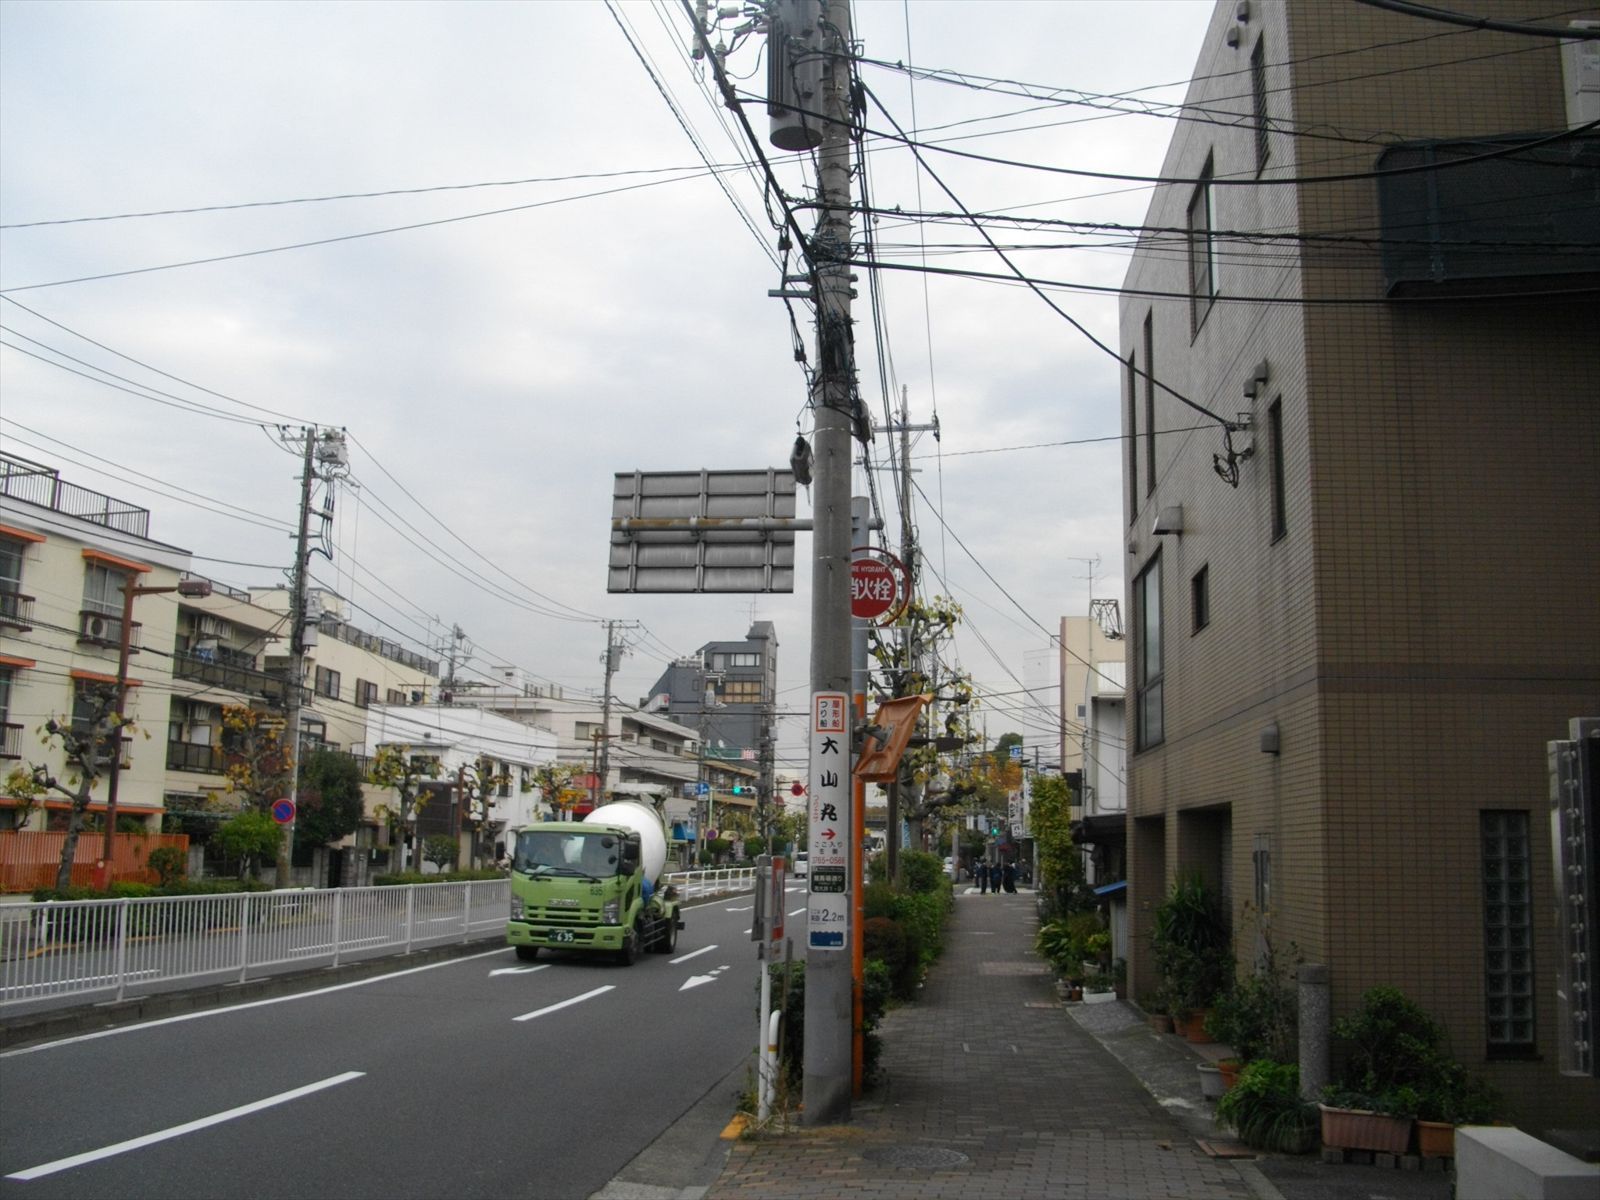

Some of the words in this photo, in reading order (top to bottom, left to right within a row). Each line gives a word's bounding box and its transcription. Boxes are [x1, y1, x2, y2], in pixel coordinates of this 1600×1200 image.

[820, 700, 828, 728] つり船
[822, 908, 845, 922] 2.2m
